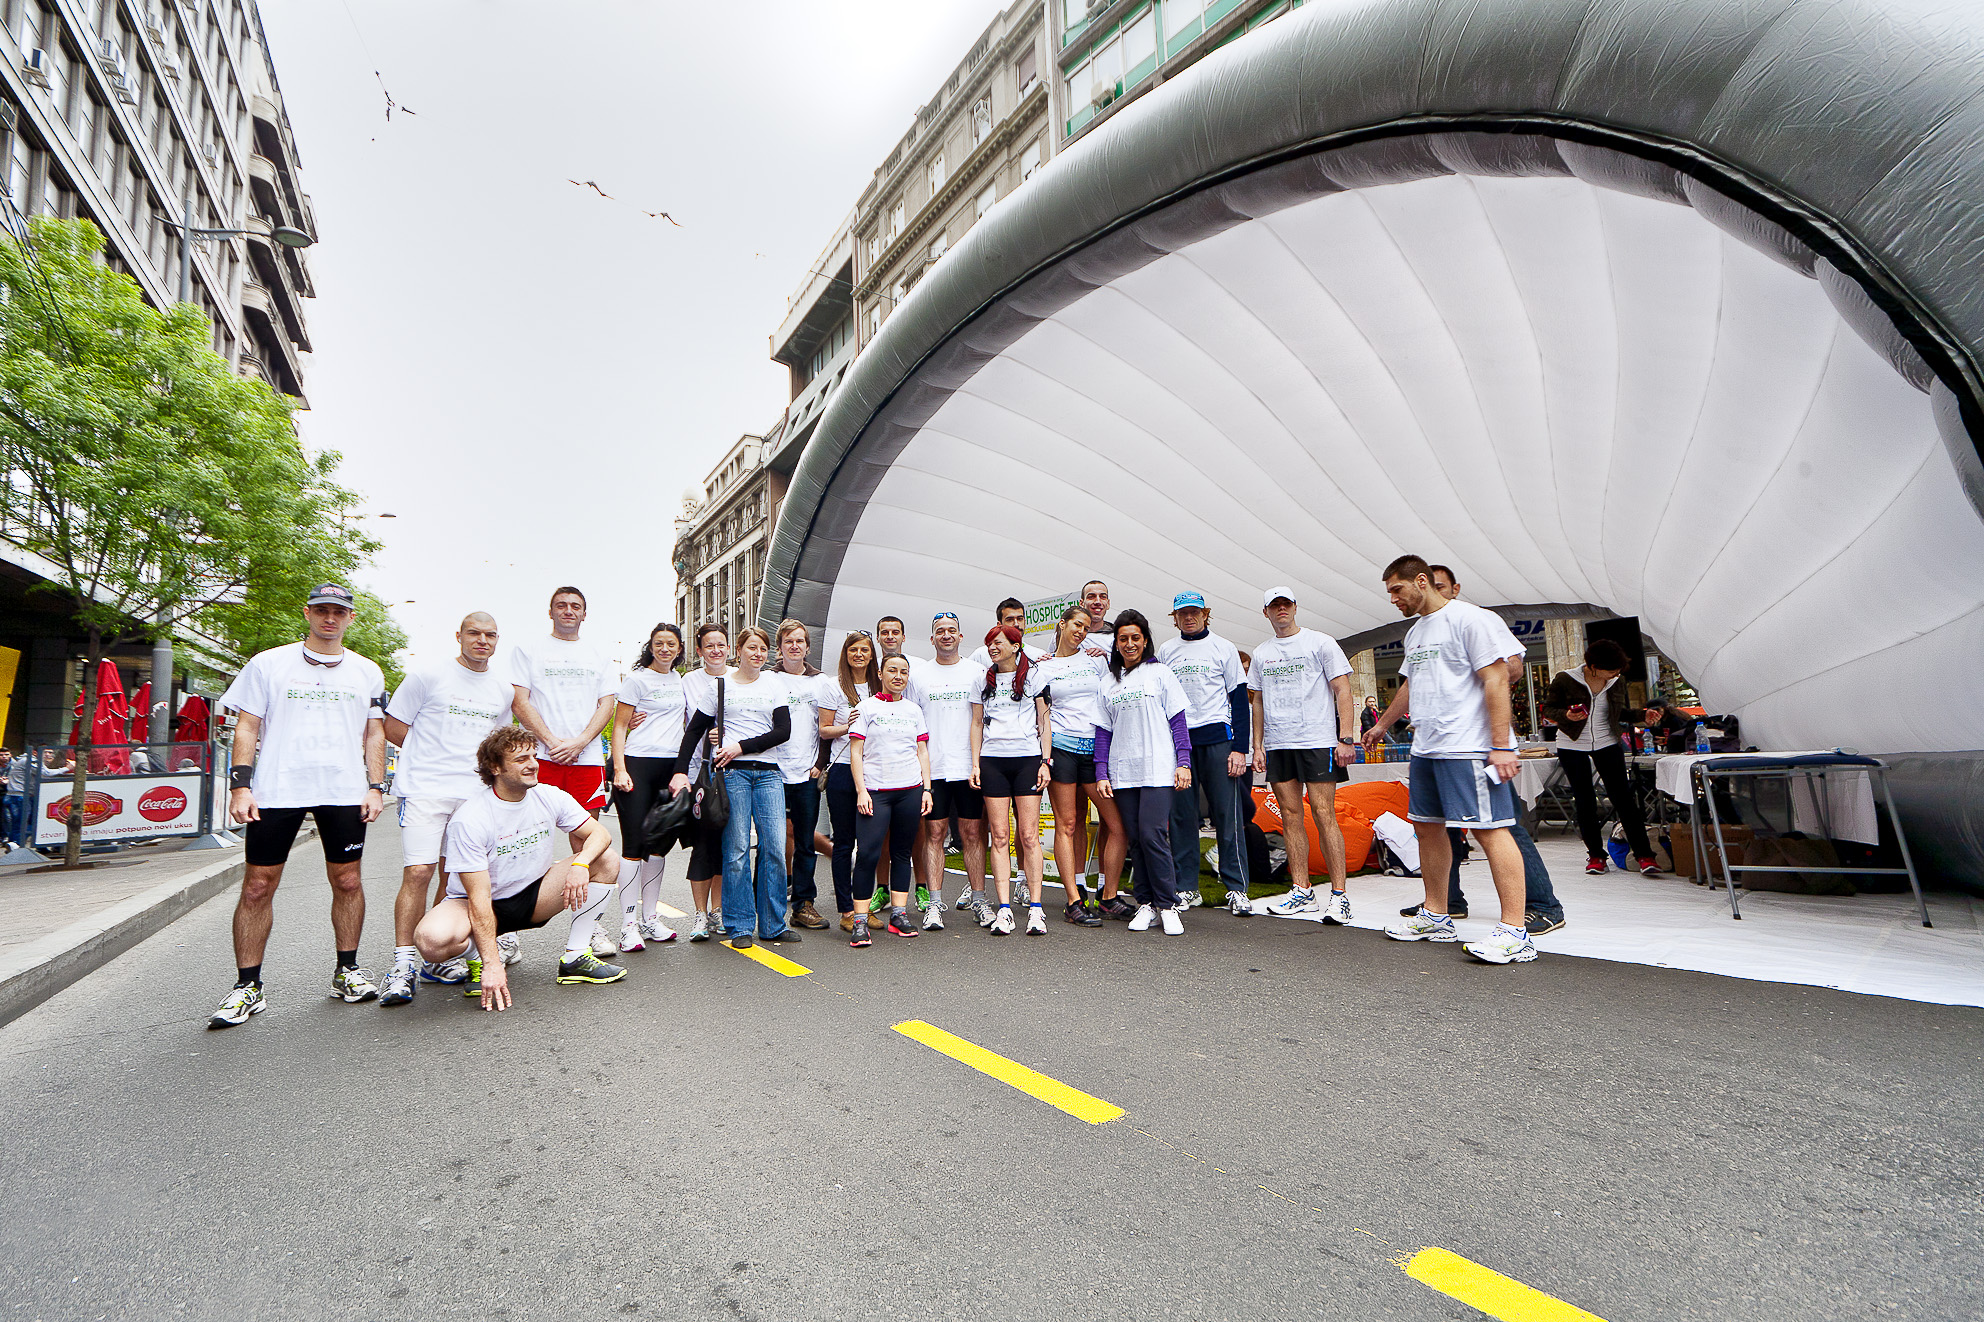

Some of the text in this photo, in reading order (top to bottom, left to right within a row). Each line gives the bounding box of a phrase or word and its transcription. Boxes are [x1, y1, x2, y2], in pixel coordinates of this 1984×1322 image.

[287, 689, 356, 702] BELHOSPICE TIM
[65, 804, 105, 813] TMA
[90, 828, 114, 836] imaju
[115, 823, 152, 834] potpuno
[154, 822, 172, 830] novi
[174, 821, 193, 829] ukus
[497, 834, 538, 856] BELHOSPICE
